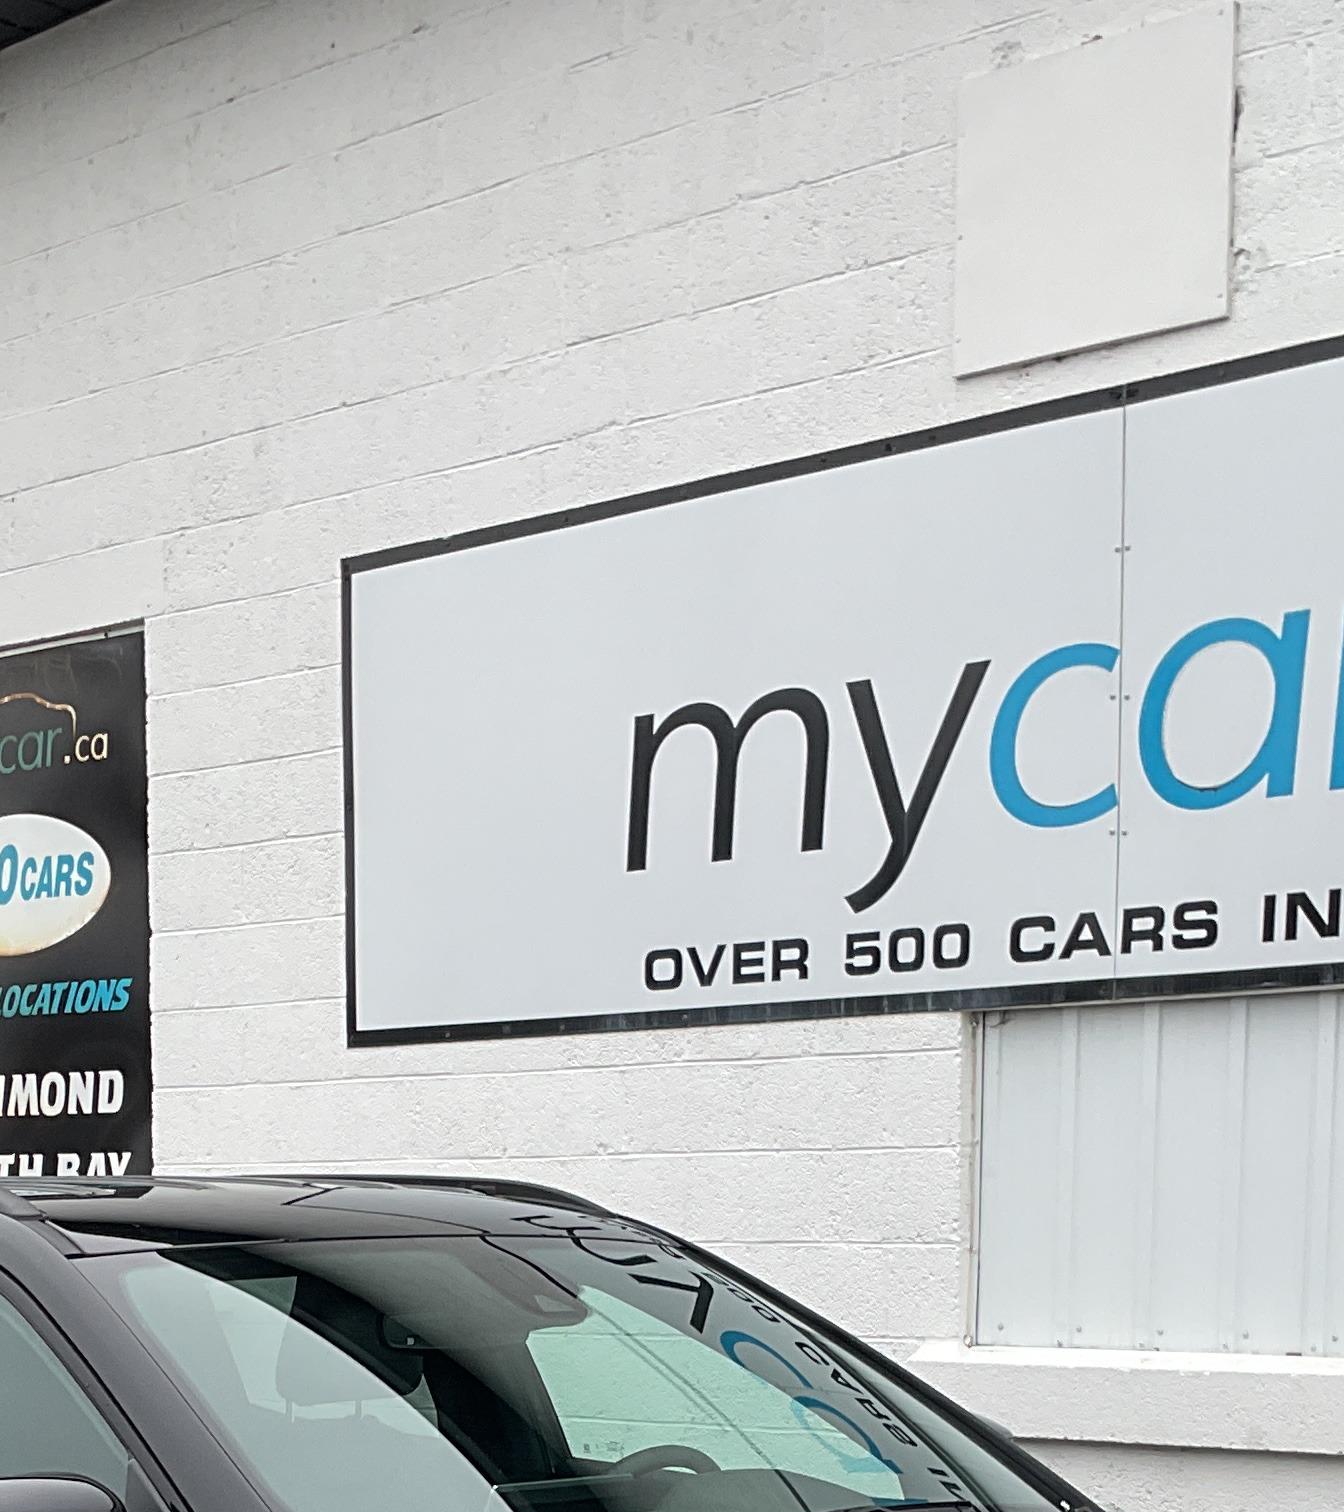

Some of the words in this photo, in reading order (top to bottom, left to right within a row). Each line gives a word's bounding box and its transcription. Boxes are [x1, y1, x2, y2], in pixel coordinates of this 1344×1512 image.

[644, 938, 809, 991] OVER
[844, 923, 970, 976] 500
[1009, 900, 1219, 962] CARS
[1262, 888, 1341, 942] IN
